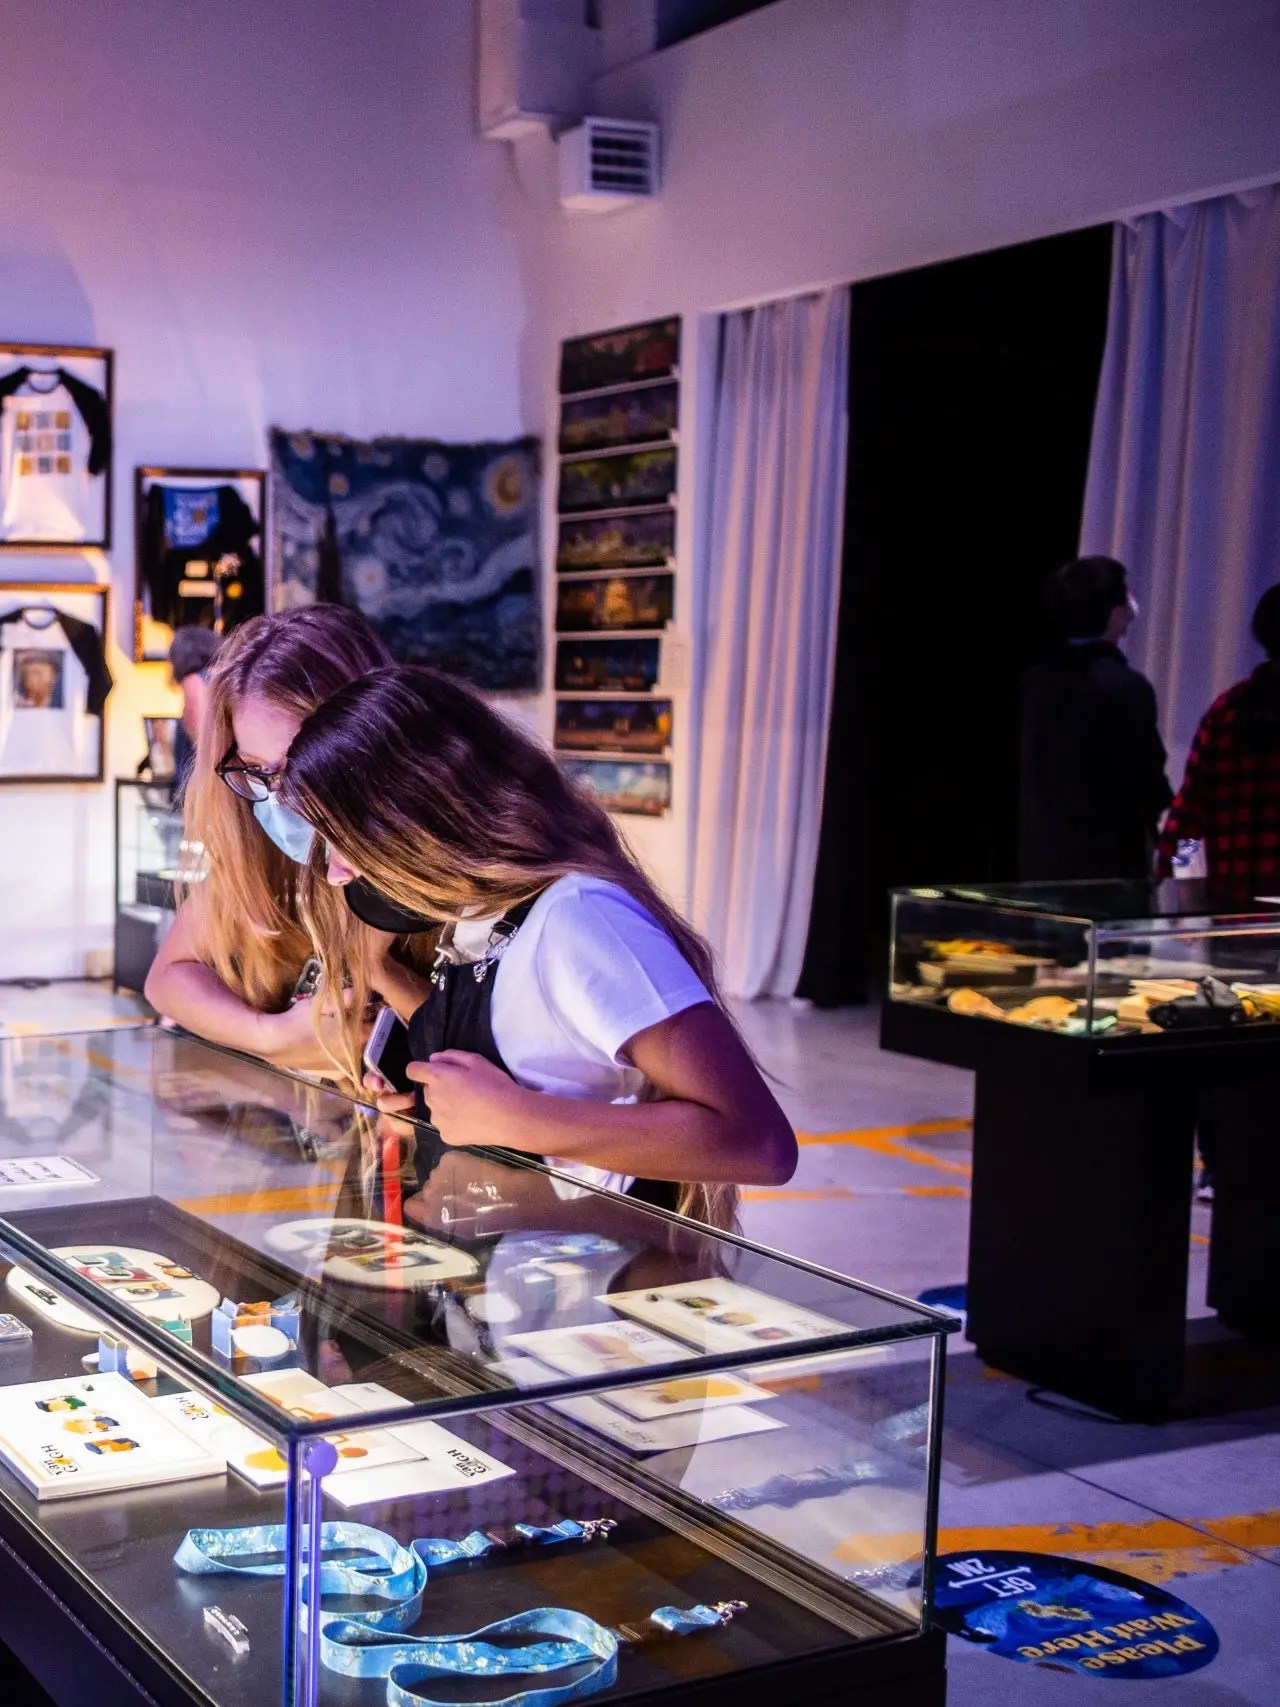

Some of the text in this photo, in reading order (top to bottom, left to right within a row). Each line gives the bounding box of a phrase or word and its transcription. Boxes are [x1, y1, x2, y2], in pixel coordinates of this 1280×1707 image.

[946, 1557, 996, 1578] 2M
[981, 1575, 1037, 1598] 6FT
[1016, 1612, 1196, 1659] Wait Here
[1078, 1633, 1206, 1669] Please
